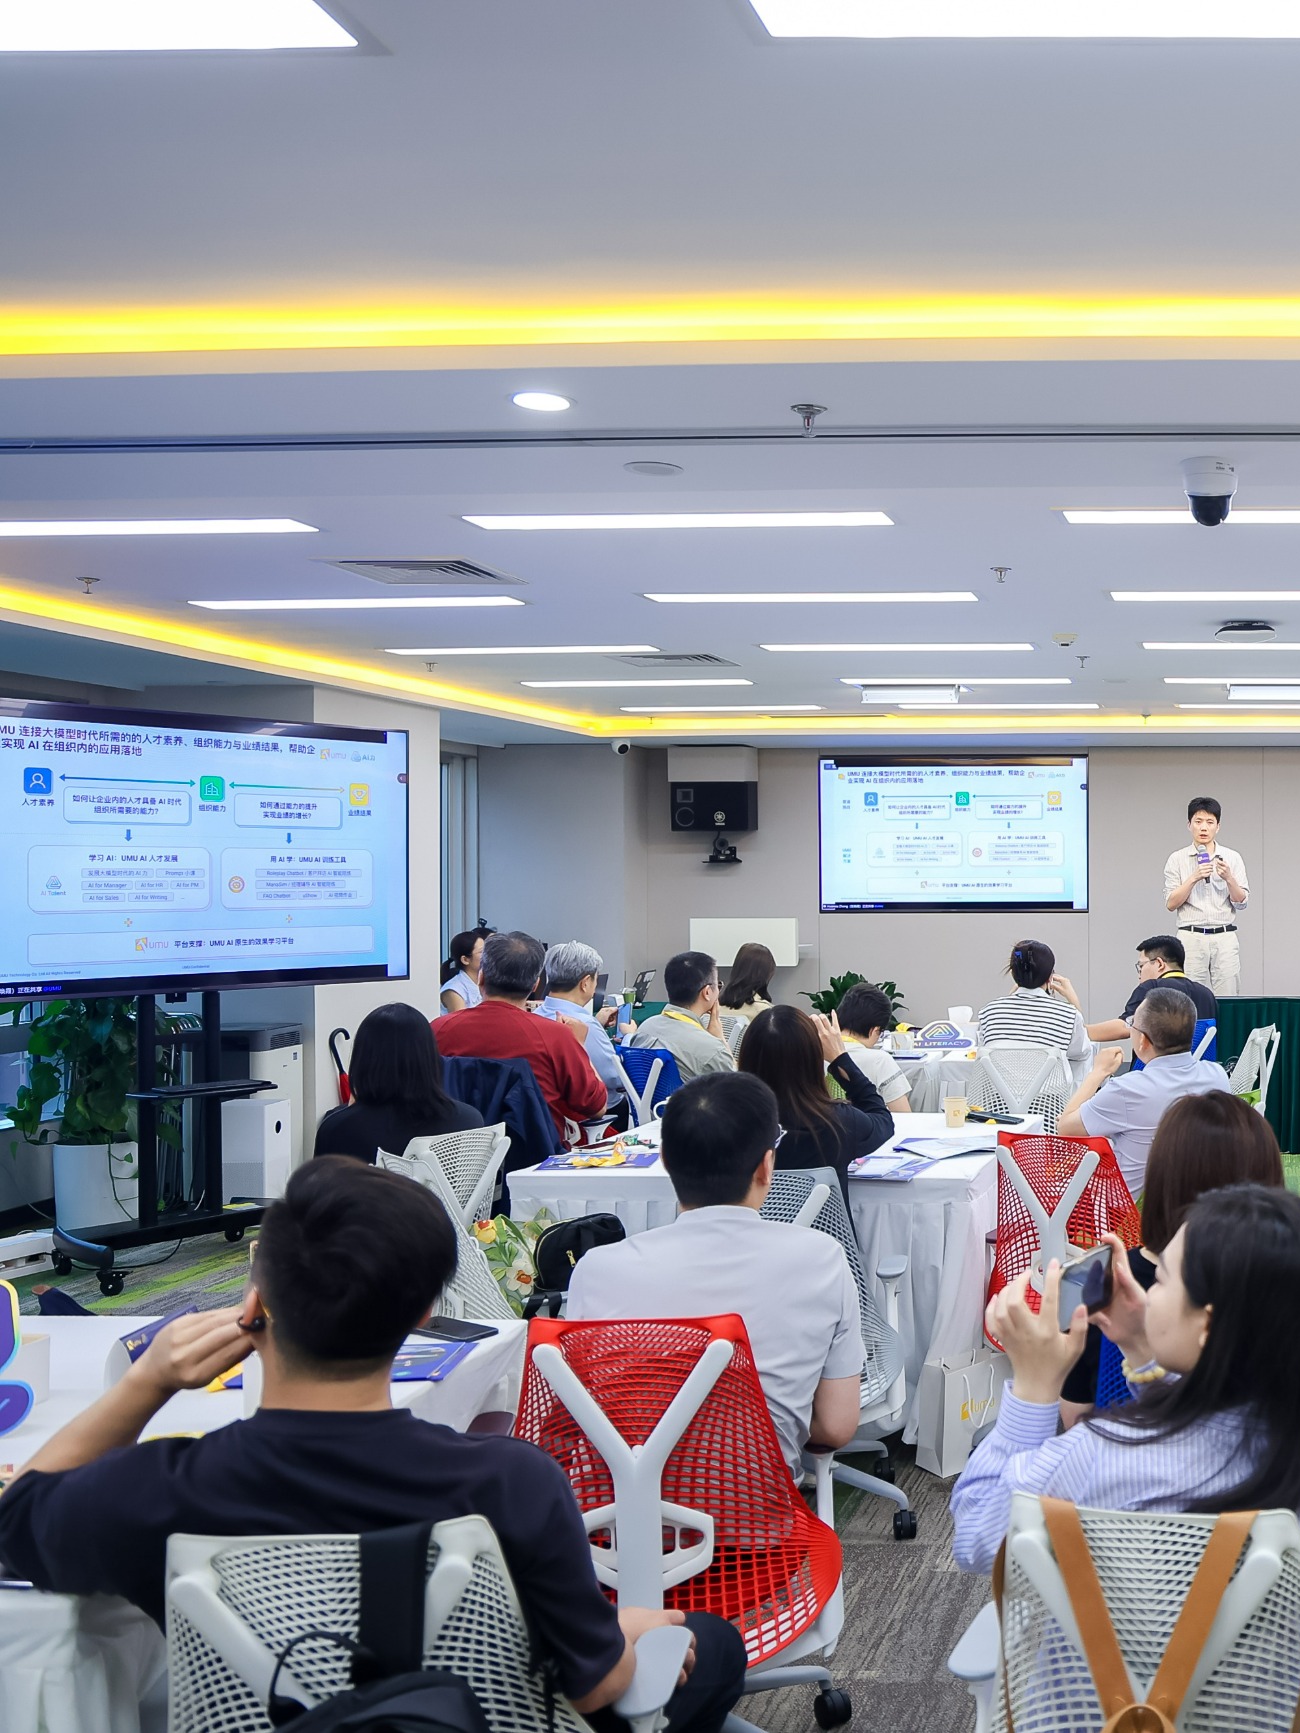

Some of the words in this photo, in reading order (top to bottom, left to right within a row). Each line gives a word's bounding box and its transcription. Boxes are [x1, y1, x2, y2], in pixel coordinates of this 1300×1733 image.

[28, 740, 39, 750] AI
[42, 740, 143, 757] 在组织内的应用落地
[22, 798, 55, 807] 人才素养
[72, 794, 157, 805] 如何让企业内的人才具备
[167, 798, 182, 806] 时代
[198, 804, 226, 813] 组织能力
[260, 801, 317, 811] 如何通过能力的提升
[88, 854, 104, 862] 学习
[148, 854, 178, 863] 人才发展
[103, 882, 127, 890] Manager
[209, 939, 225, 947] UMU
[226, 939, 233, 947] AI
